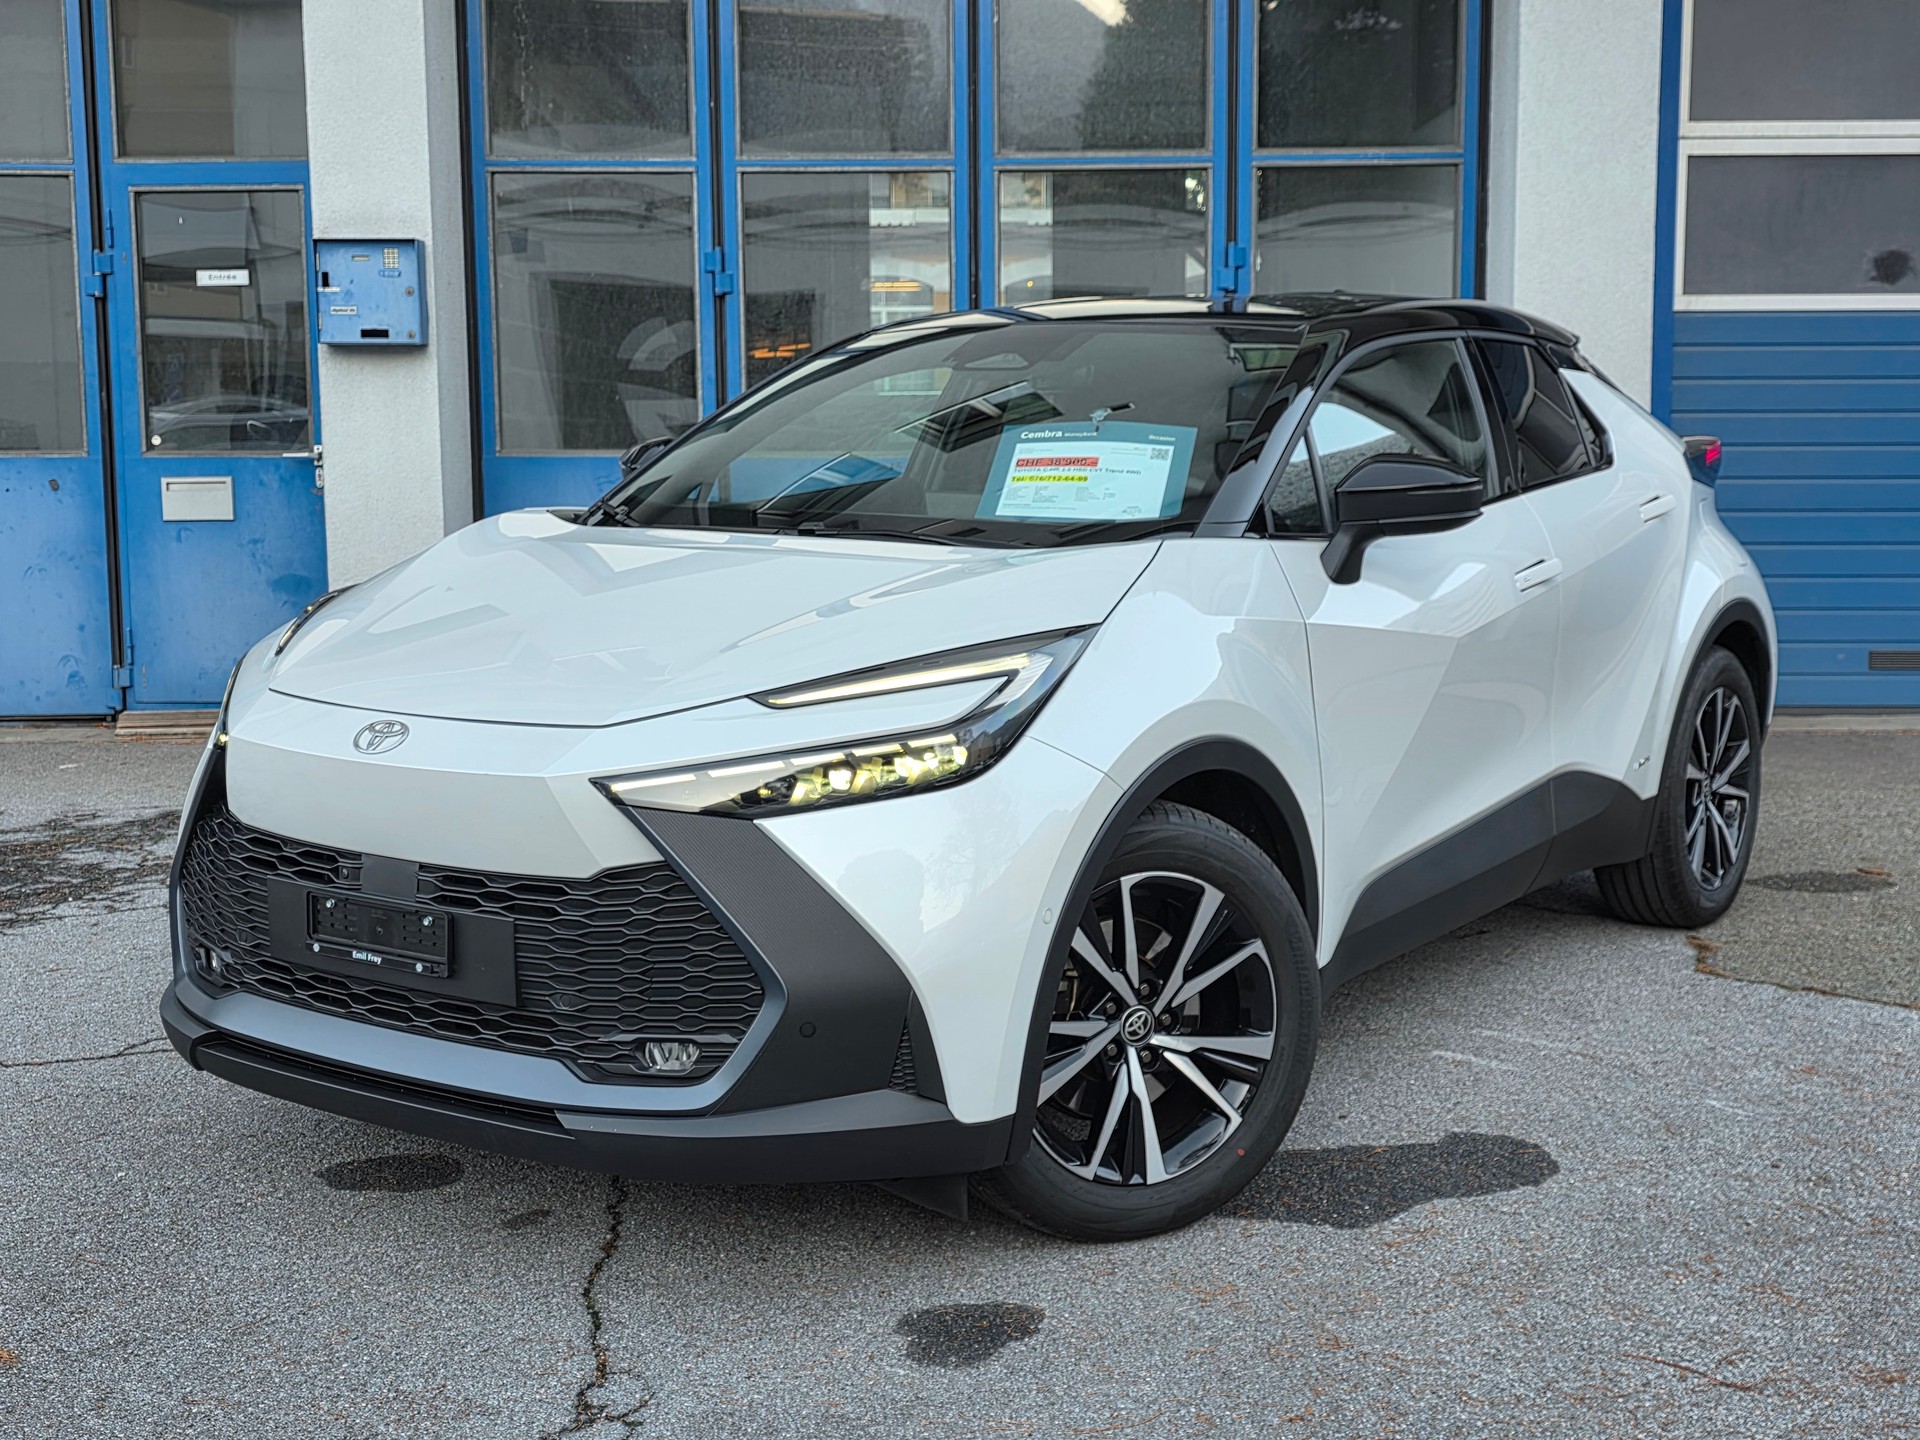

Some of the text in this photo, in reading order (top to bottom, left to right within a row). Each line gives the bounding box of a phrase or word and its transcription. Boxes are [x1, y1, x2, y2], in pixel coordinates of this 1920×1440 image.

[1020, 430, 1063, 440] Cembra
[1016, 458, 1042, 467] CHF
[352, 950, 382, 965] Emil Frey
